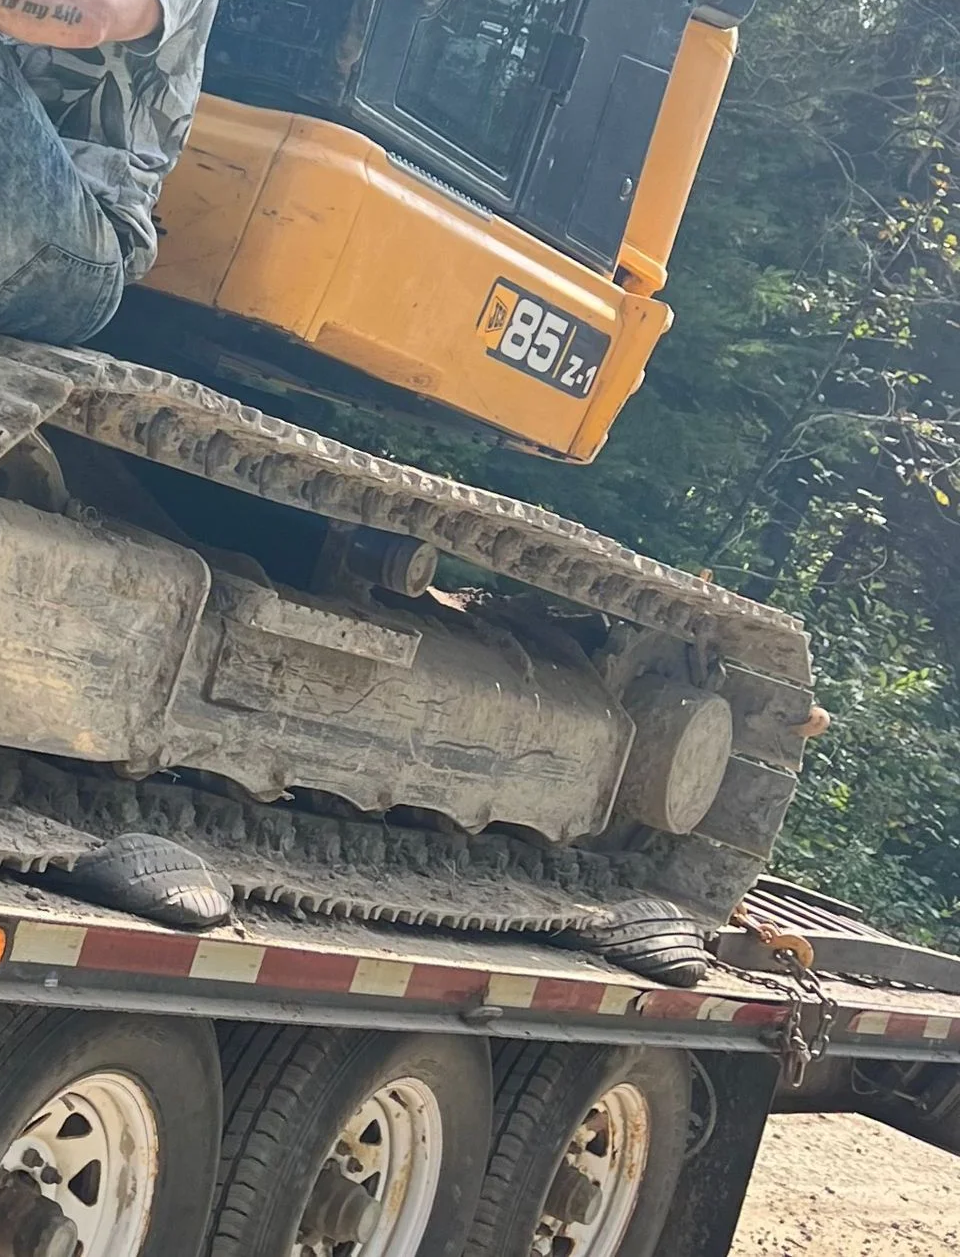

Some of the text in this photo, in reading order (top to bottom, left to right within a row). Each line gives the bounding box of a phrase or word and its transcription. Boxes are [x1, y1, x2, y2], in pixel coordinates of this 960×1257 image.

[22, 0, 49, 20] my
[51, 3, 83, 26] Life
[500, 298, 569, 373] 85
[560, 354, 598, 394] Z-1
